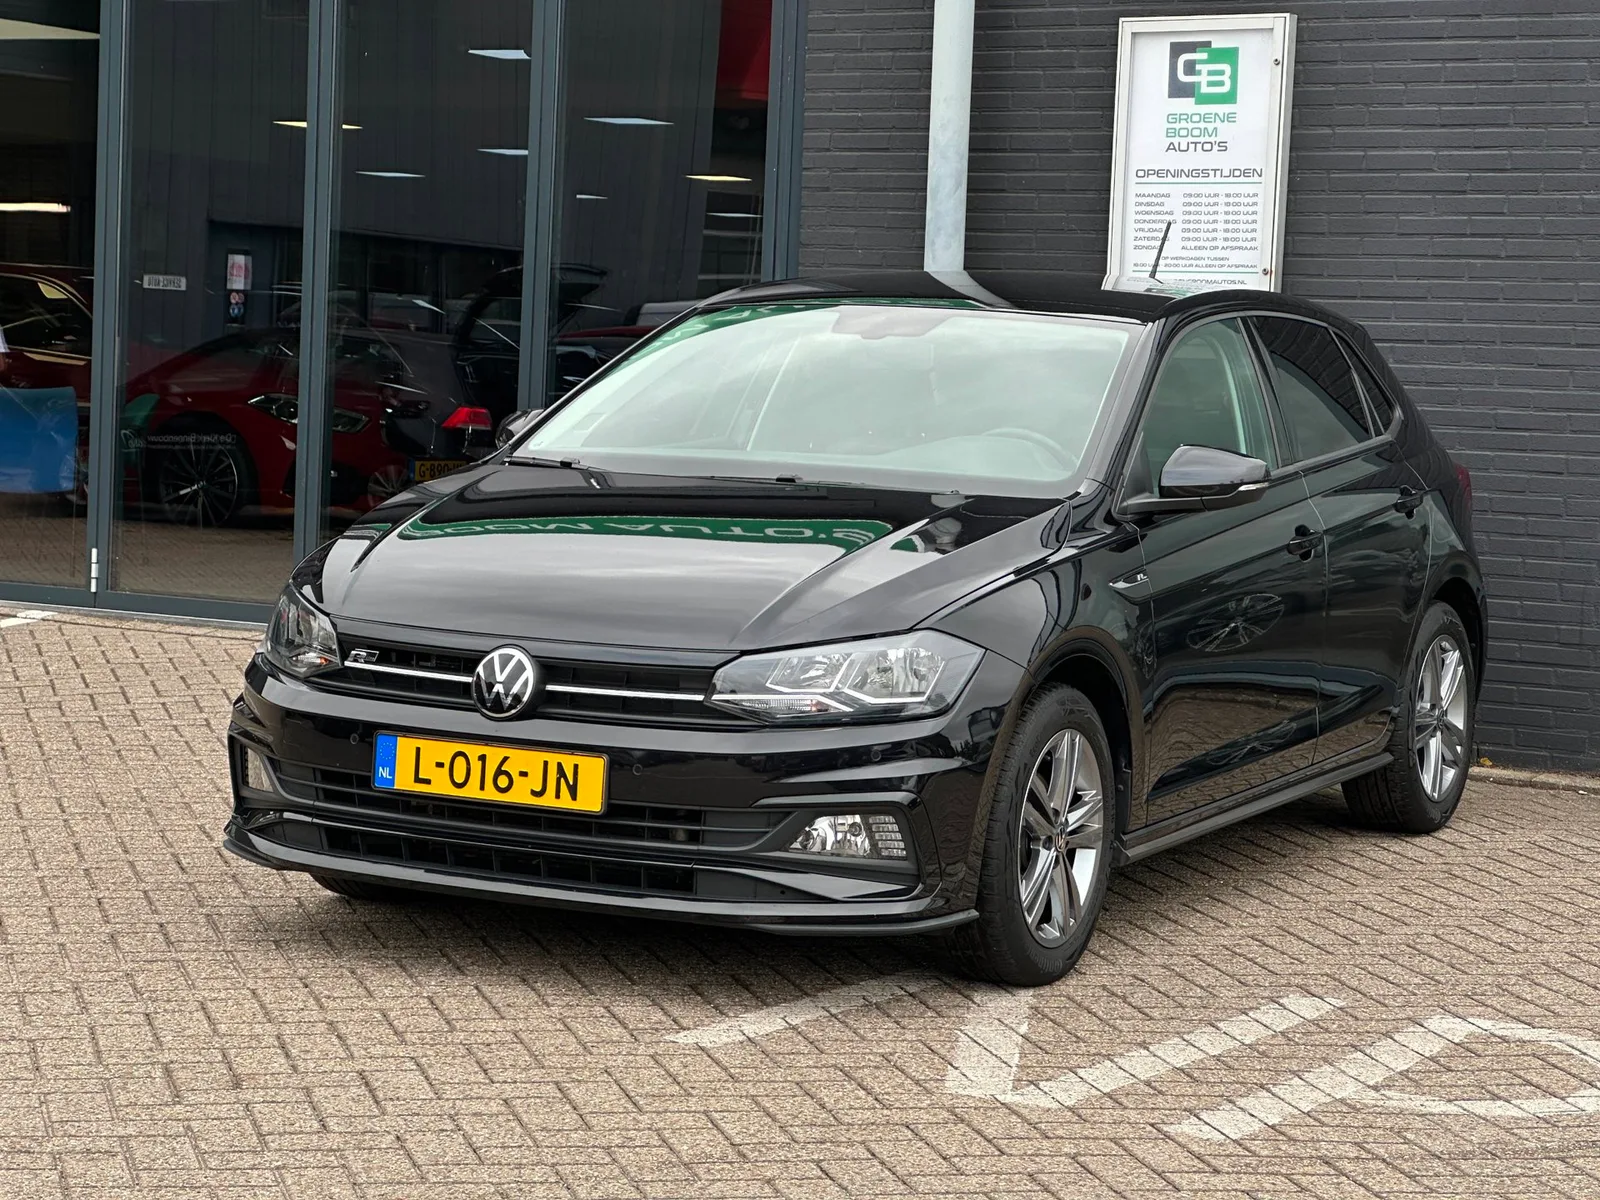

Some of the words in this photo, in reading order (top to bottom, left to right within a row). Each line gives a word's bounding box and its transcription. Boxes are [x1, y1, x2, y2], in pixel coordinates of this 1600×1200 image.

[1166, 112, 1237, 124] GROENE
[1165, 126, 1218, 138] BOOM
[1165, 141, 1228, 153] AUTO'S
[1135, 167, 1263, 179] OPENINGSTIJDEN
[418, 463, 463, 478] G-890-
[378, 766, 393, 780] NL
[413, 745, 579, 802] L-016-JN
